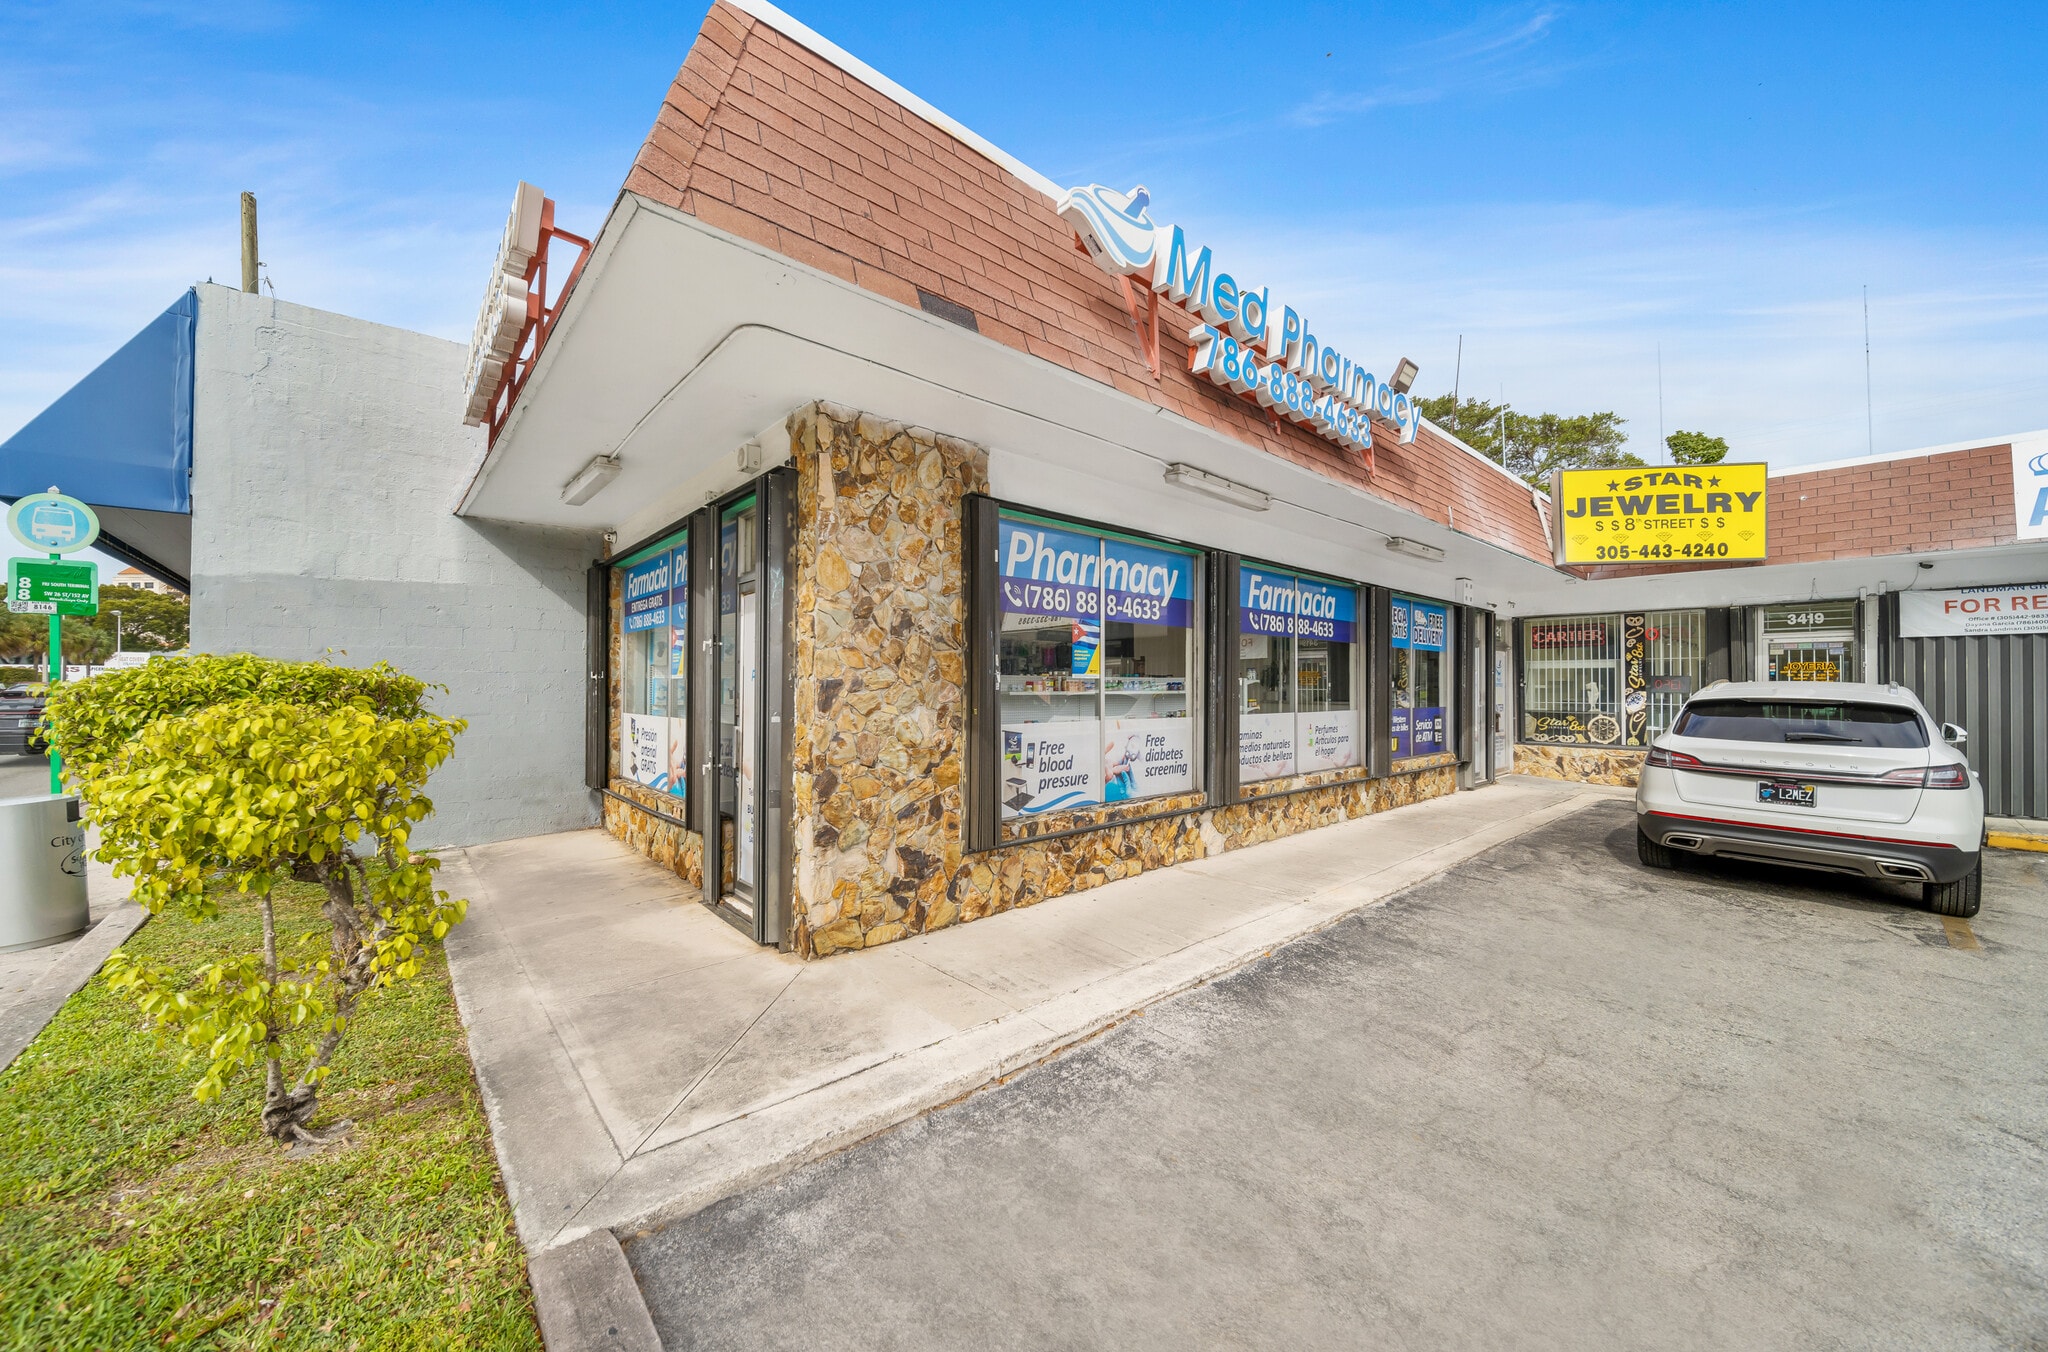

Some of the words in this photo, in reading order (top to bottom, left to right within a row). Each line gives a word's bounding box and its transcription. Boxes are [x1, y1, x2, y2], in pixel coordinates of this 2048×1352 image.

[1164, 224, 1269, 342] Med
[1276, 304, 1423, 445] Pharmacy
[1199, 324, 1372, 449] 786-888-4633
[1624, 472, 1703, 492] STAR
[1566, 491, 1763, 519] JEWELRY
[1644, 518, 1695, 530] STREET
[1596, 542, 1729, 560] 305-443-4240
[1006, 531, 1179, 607] Pharmacy
[18, 577, 32, 588] 8
[627, 560, 668, 599] Farmacia
[17, 588, 31, 600] 8
[648, 594, 663, 609] GRATIS
[1024, 583, 1071, 613] (786)
[1248, 574, 1336, 620] Farmacia
[1944, 597, 2001, 615] FOR
[1260, 613, 1285, 633] (786)
[1428, 613, 1443, 630] FREE
[1787, 612, 1825, 625] 3419
[1413, 627, 1443, 646] DELIVERY
[1533, 629, 1604, 643] CARTIER
[1628, 657, 1646, 689] Star
[1783, 661, 1837, 671] JOYERIA
[1314, 724, 1339, 737] Perfumes
[1415, 718, 1433, 731] Servicio
[1537, 716, 1570, 731] Star
[1145, 734, 1166, 747] Free
[1337, 735, 1349, 746] para
[1415, 731, 1422, 743] de
[1422, 731, 1433, 742] ATM
[641, 744, 658, 759] arterial
[1038, 741, 1065, 756] Free
[1262, 739, 1291, 751] naturales
[1145, 748, 1184, 762] diabetes
[1263, 752, 1272, 763] de
[1272, 751, 1293, 762] belleza
[1314, 747, 1321, 757] el
[1321, 747, 1337, 759] hogar
[641, 758, 657, 775] GRATIS
[1038, 754, 1074, 773] blood
[1145, 761, 1188, 777] screening
[1722, 757, 1858, 770] LINCOLN
[1038, 773, 1089, 794] pressure
[51, 835, 76, 848] City
